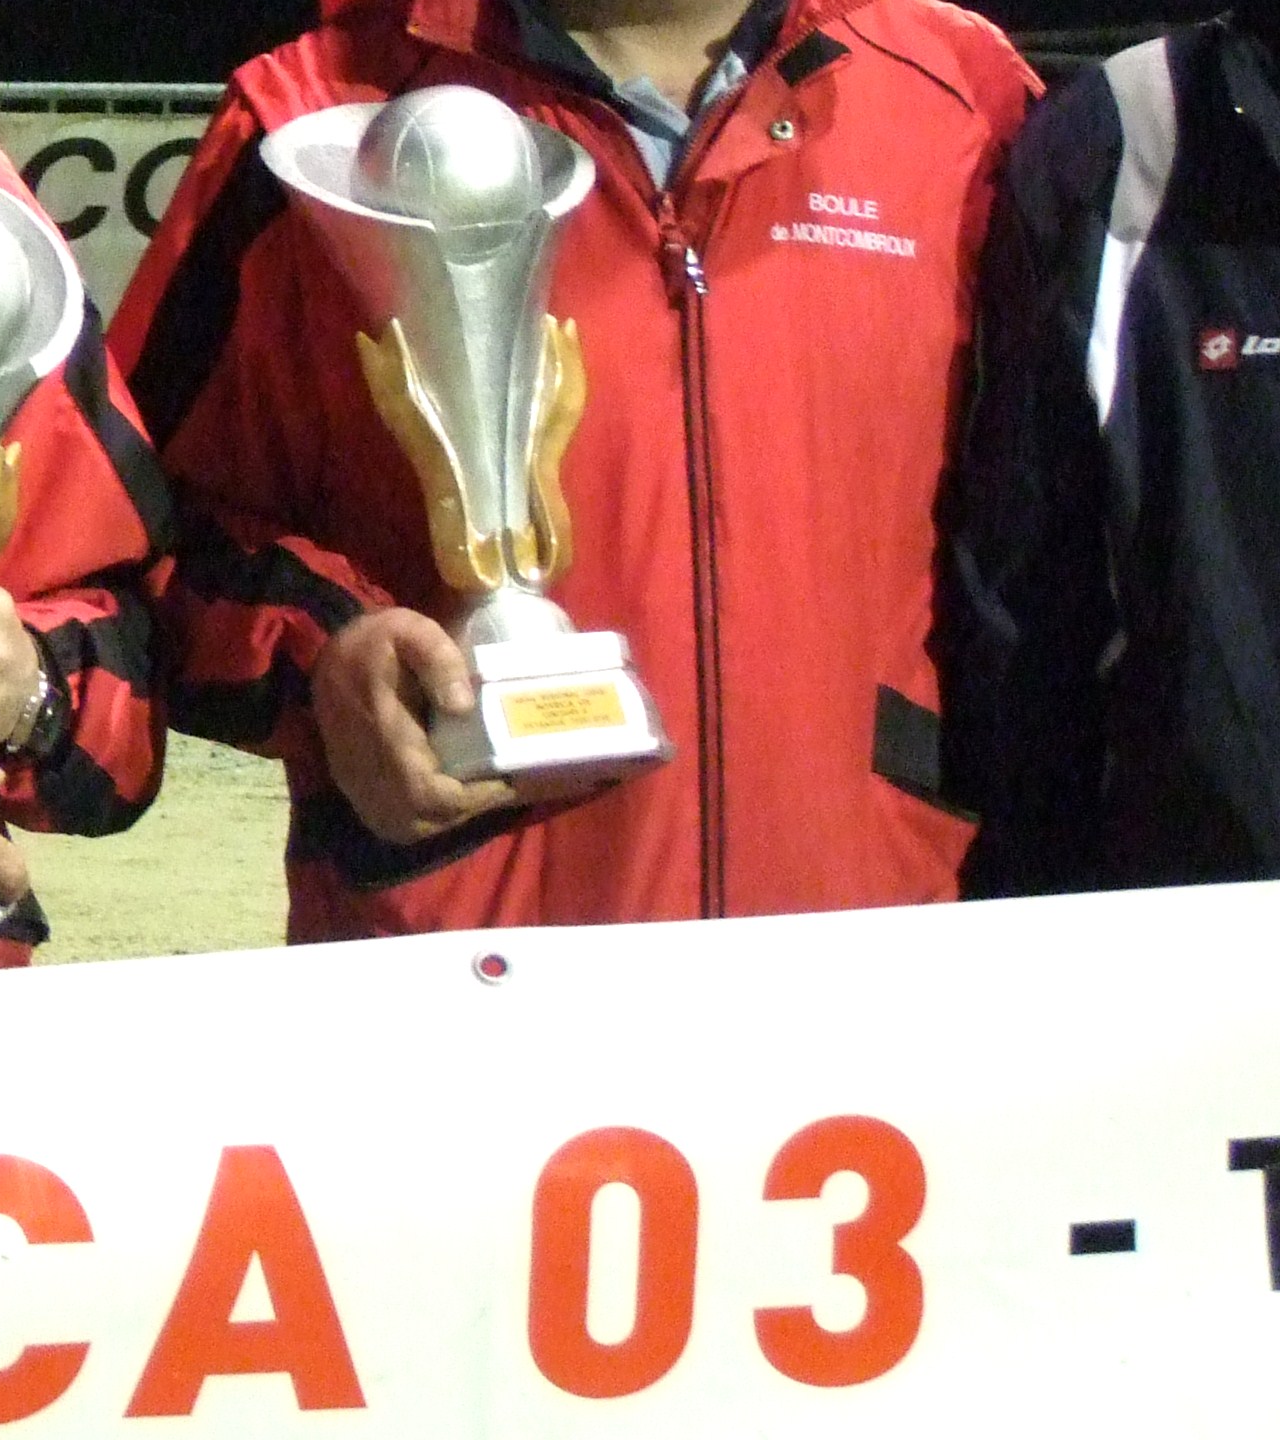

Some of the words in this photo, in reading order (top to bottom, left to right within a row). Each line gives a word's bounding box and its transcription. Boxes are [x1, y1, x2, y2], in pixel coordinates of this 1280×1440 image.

[808, 192, 879, 220] BOULE
[770, 221, 789, 242] de
[791, 221, 917, 258] MONTCOMBROUX
[528, 1113, 927, 1398] 03
